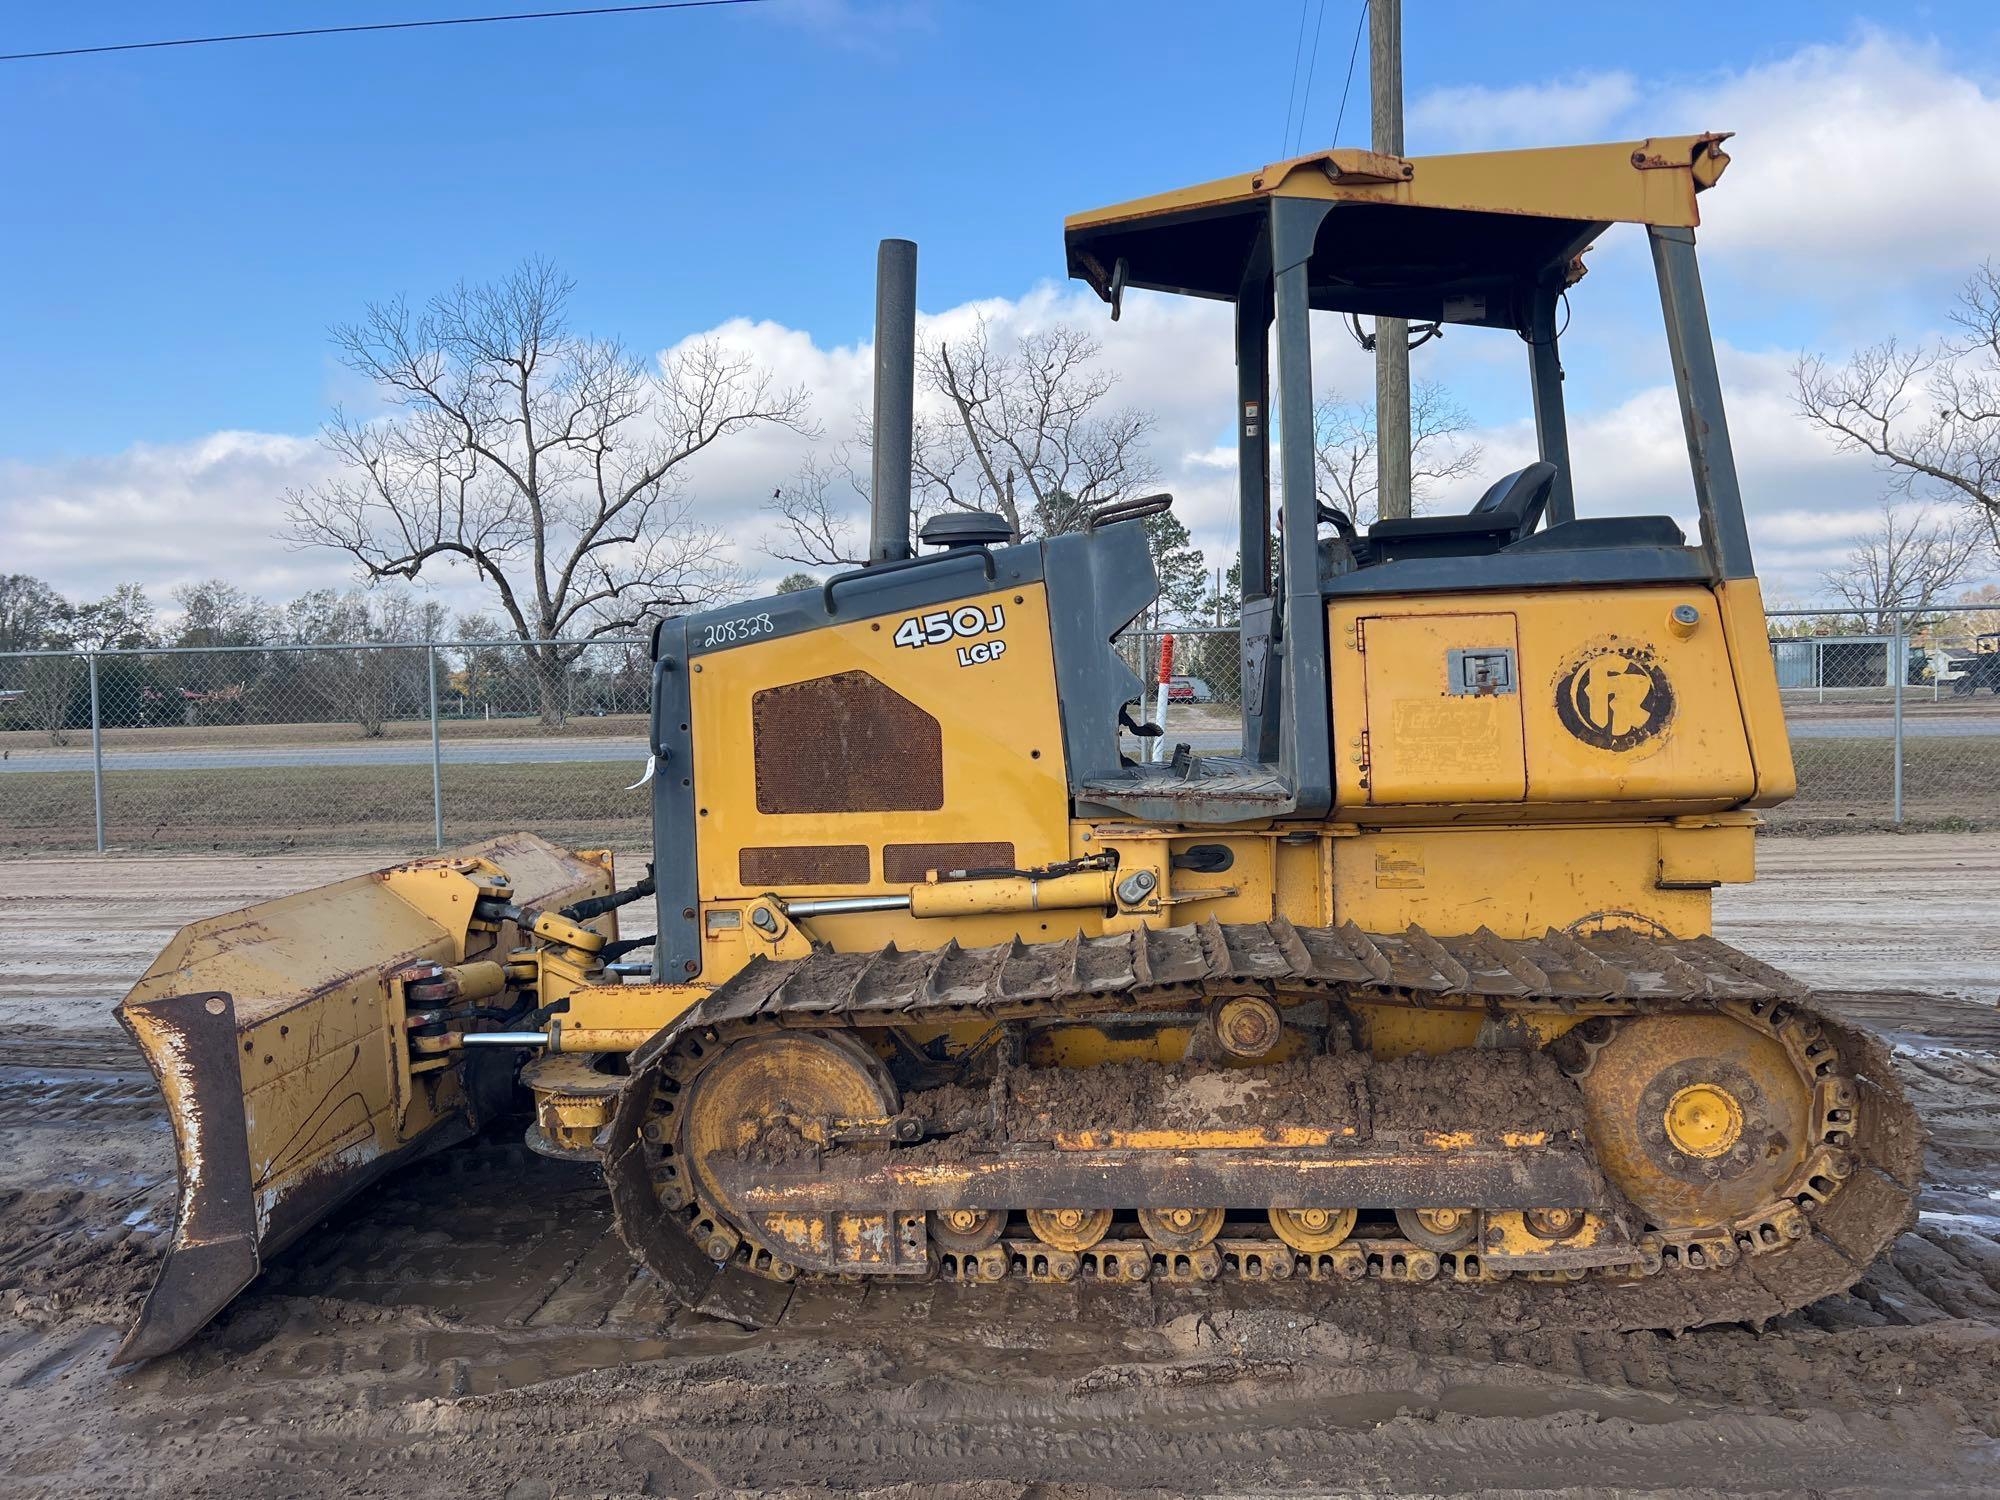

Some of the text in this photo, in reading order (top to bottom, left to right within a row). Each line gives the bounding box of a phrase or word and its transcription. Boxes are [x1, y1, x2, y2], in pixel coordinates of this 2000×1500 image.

[704, 612, 774, 648] 208328
[893, 604, 1006, 649] 450J
[956, 639, 1007, 668] LGP
